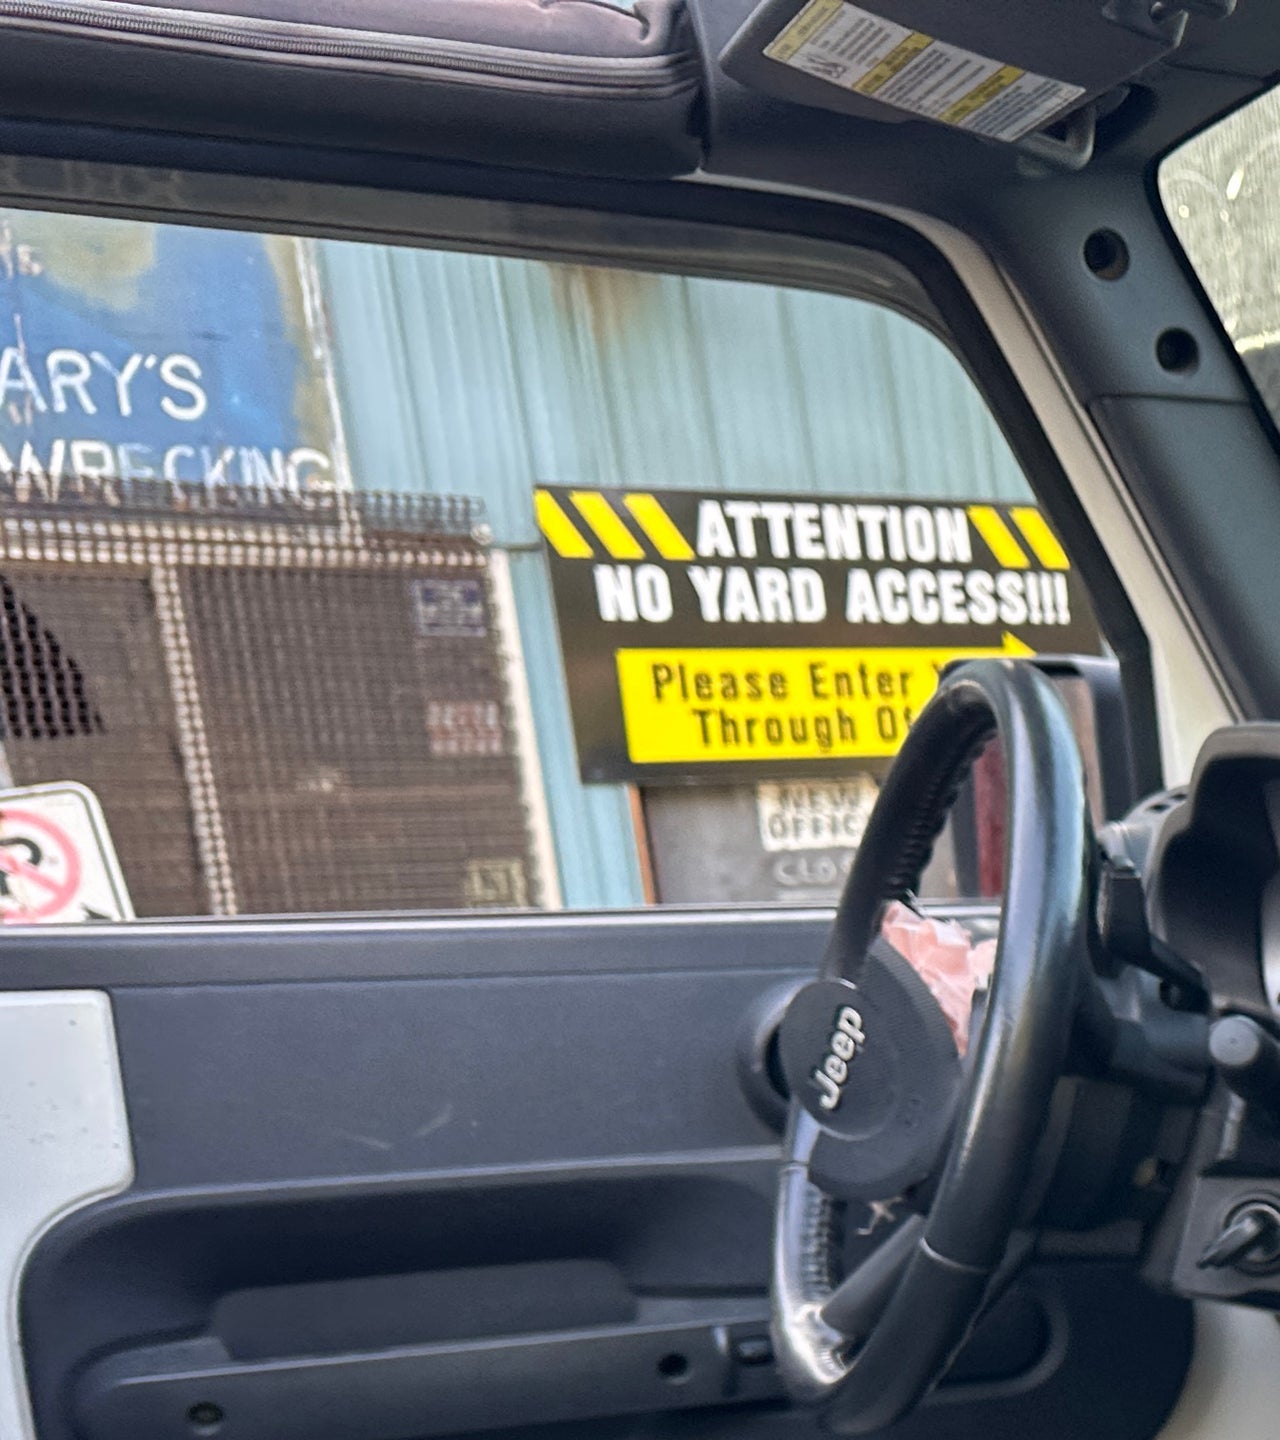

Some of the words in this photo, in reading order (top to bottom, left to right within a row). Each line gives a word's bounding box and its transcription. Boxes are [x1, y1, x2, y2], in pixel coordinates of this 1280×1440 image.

[696, 498, 973, 564] ATTENTION
[593, 562, 674, 623] NO
[686, 564, 828, 624] YARD
[845, 566, 1072, 626] ACCESS!!!
[651, 662, 789, 702] Please
[808, 660, 912, 701] Enter
[691, 706, 858, 750] Through
[814, 1006, 866, 1110] Jeep
